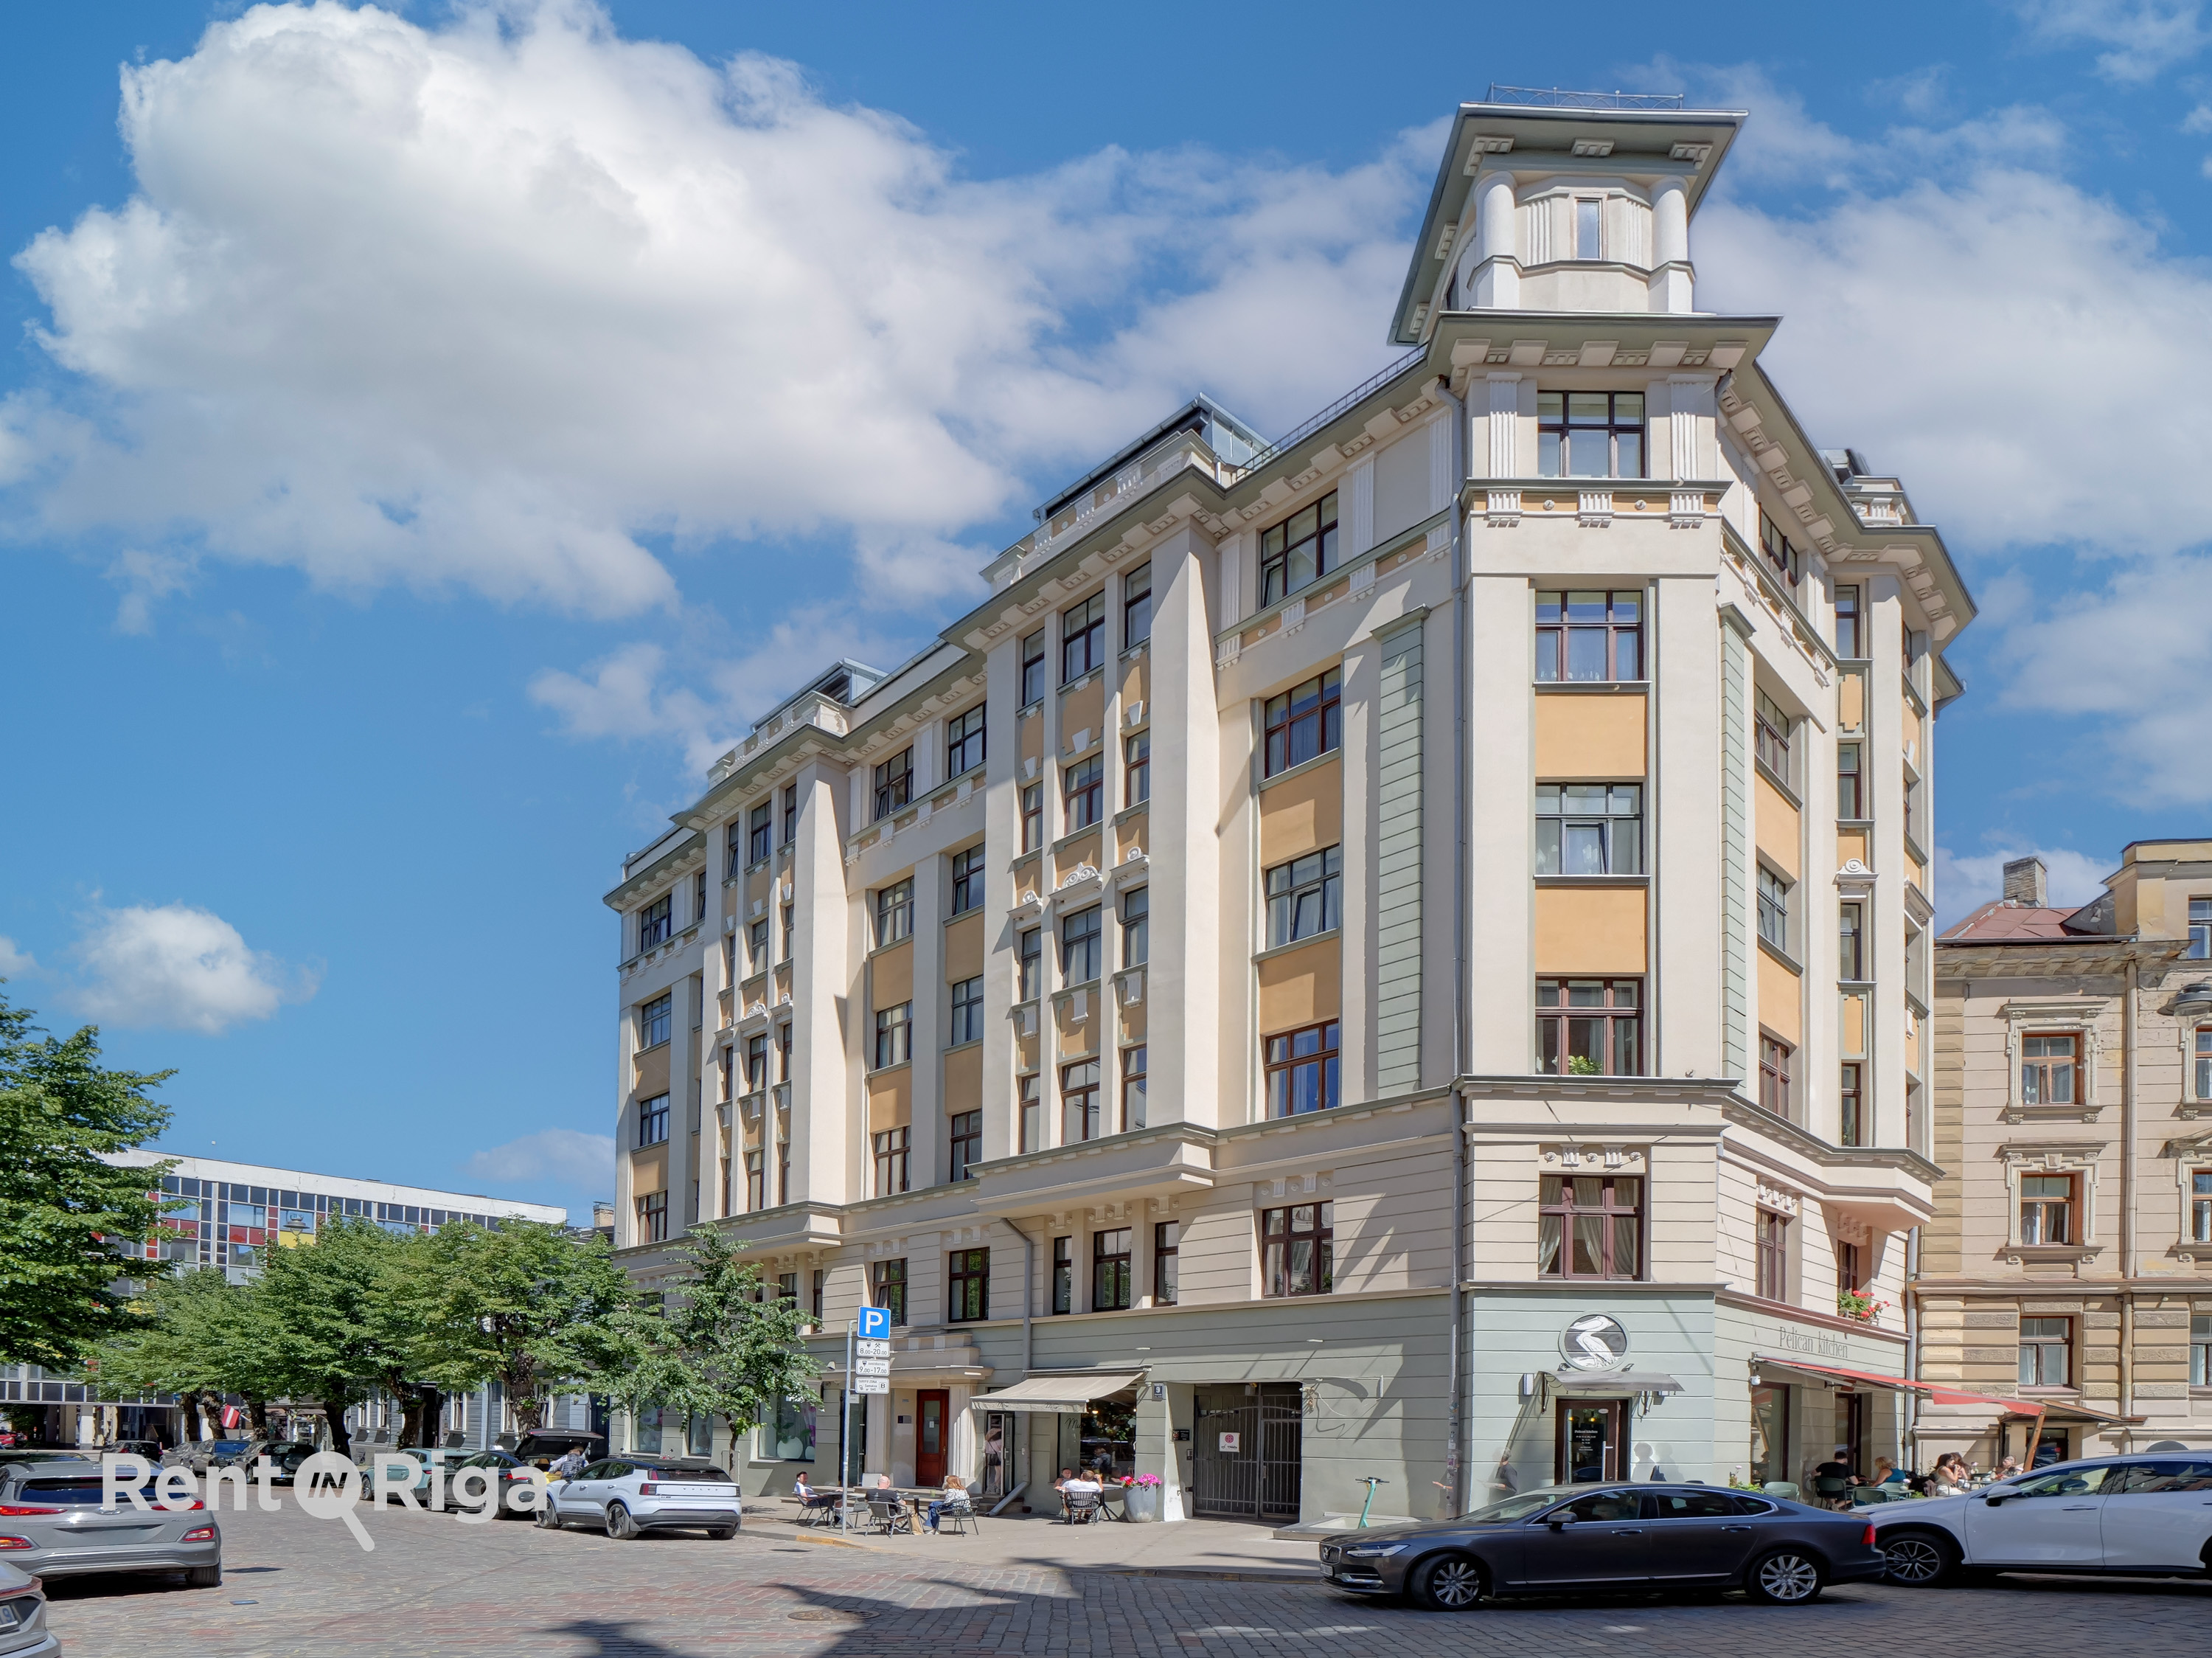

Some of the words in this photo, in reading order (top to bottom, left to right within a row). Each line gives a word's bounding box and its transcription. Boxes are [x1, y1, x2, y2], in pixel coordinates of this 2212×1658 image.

[866, 1311, 883, 1334] P
[1779, 1326, 1814, 1352] Pelican
[1818, 1331, 1848, 1358] kitchen
